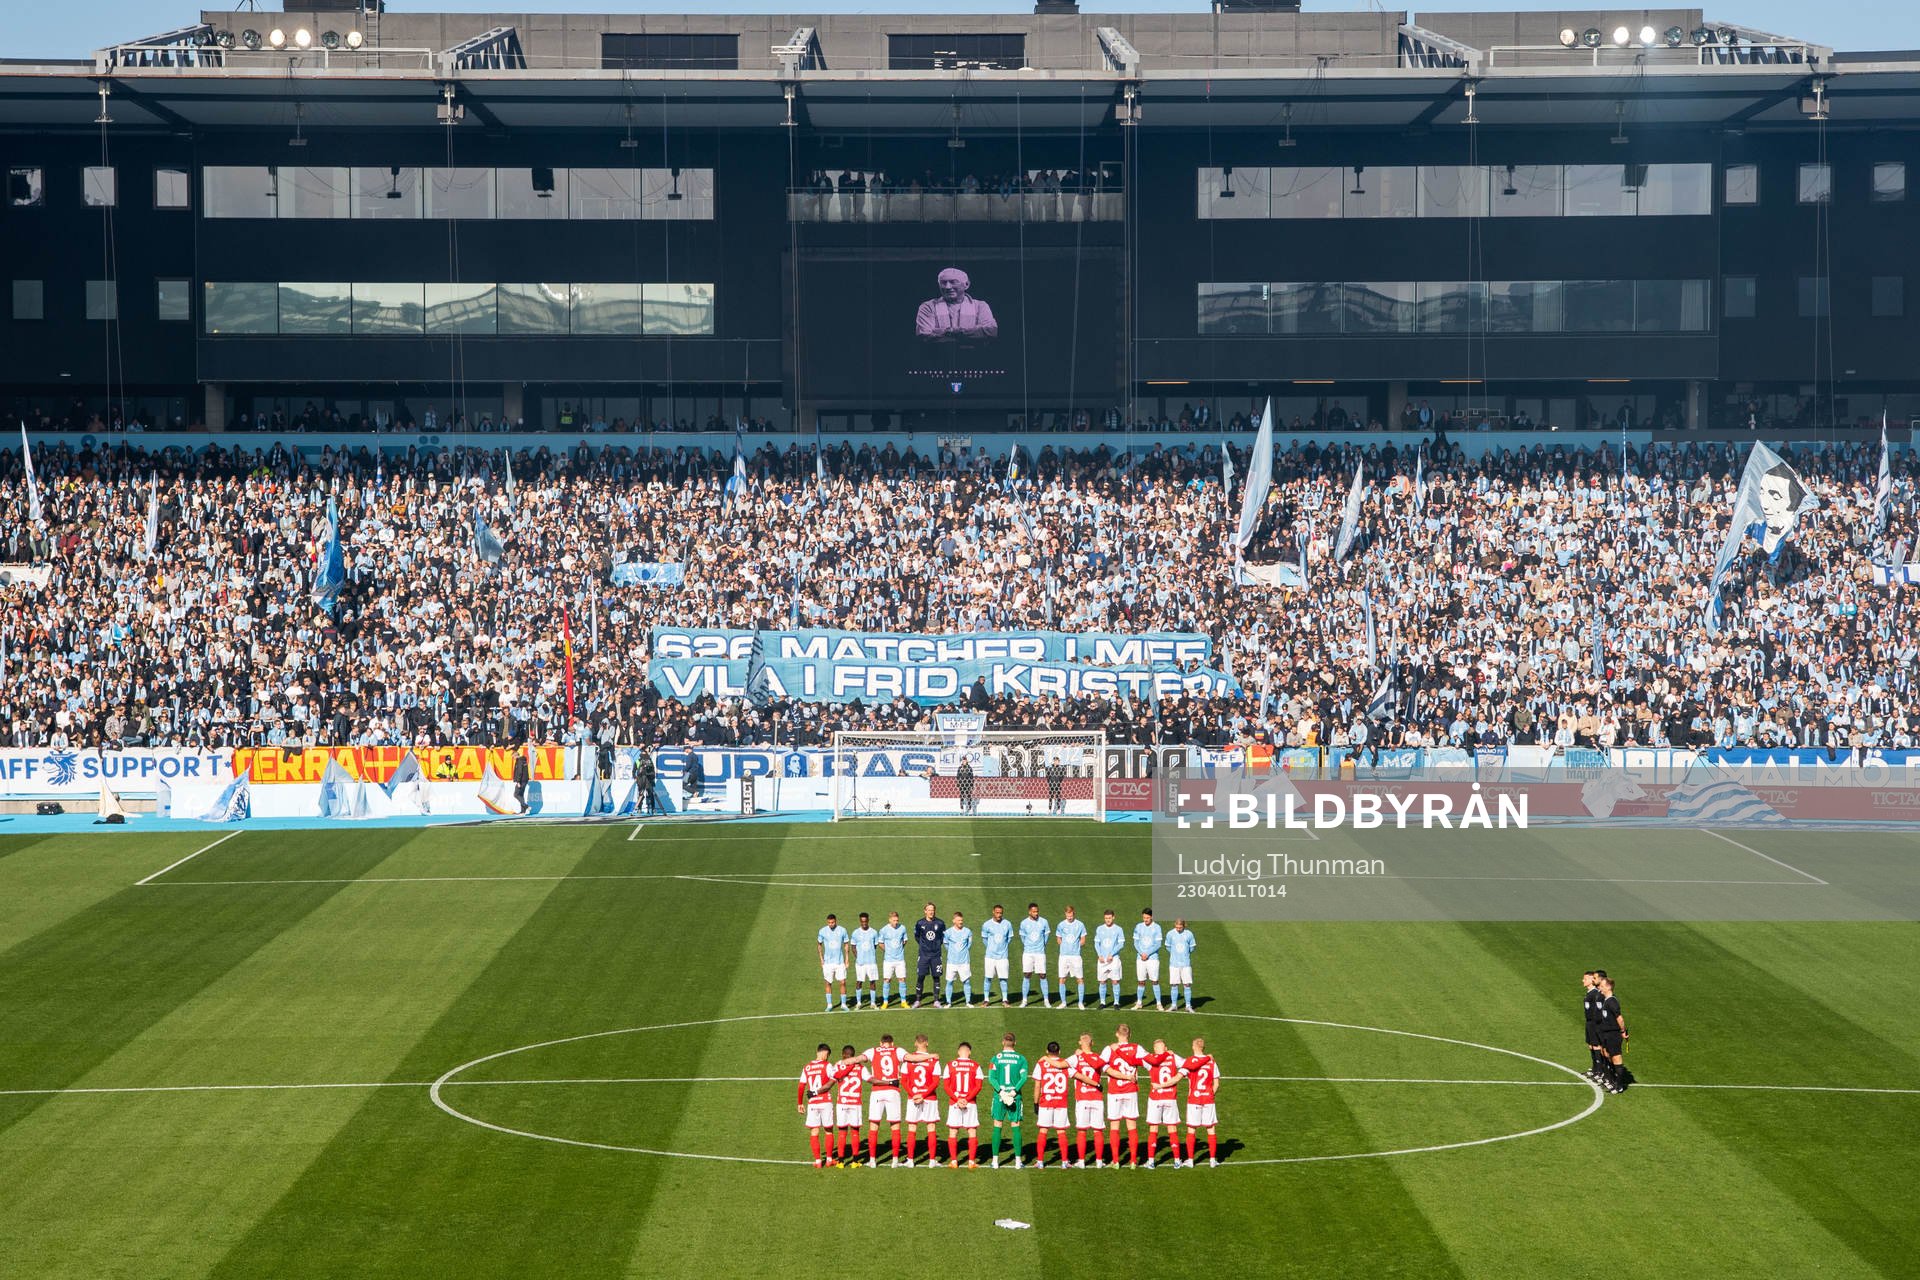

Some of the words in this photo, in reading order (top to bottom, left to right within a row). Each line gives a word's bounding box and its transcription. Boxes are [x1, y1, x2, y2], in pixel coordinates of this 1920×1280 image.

[780, 635, 1046, 662] MATCHER
[1094, 638, 1207, 668] MFF
[661, 663, 789, 698] VILA
[802, 663, 818, 697] I
[0, 758, 39, 779] FF
[235, 749, 360, 780] TERRA
[1718, 749, 1892, 788] MALMÖ
[880, 1055, 894, 1076] 9
[914, 1065, 926, 1087] 3
[1004, 1063, 1011, 1085] 1
[840, 1076, 861, 1098] 22
[956, 1072, 970, 1092] 11
[1043, 1072, 1067, 1094] 29
[1197, 1069, 1208, 1090] 2
